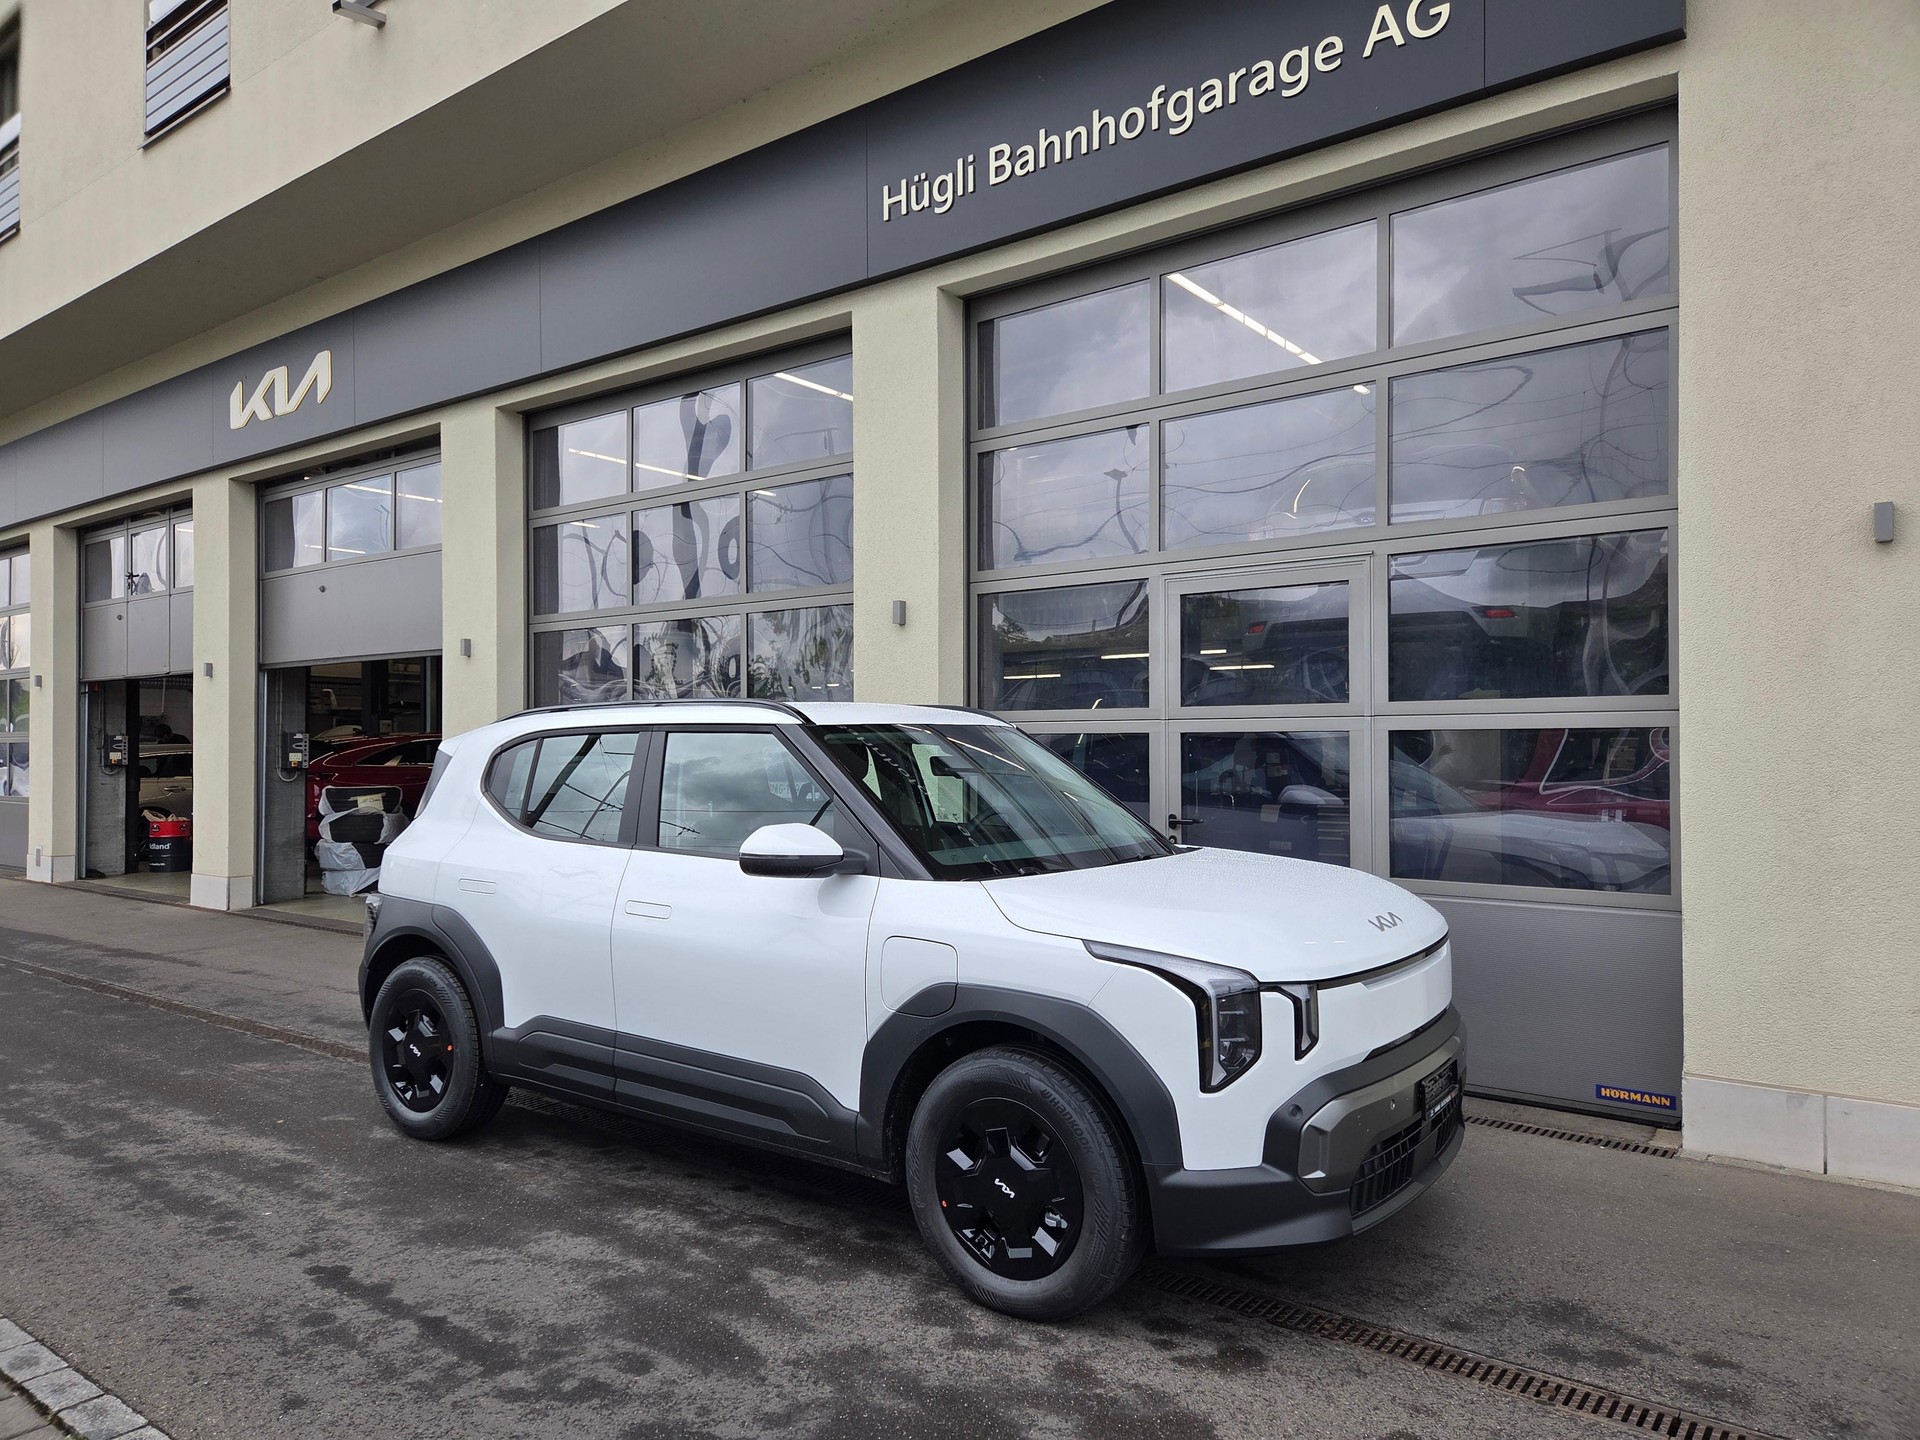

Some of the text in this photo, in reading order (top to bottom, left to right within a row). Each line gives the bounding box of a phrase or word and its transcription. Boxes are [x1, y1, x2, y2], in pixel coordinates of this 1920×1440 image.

[882, 0, 1451, 222] Hügli Bahnhofgarage AG
[229, 349, 332, 430] KIA
[1367, 911, 1404, 932] KIA
[1600, 1087, 1671, 1107] HÖRMANN
